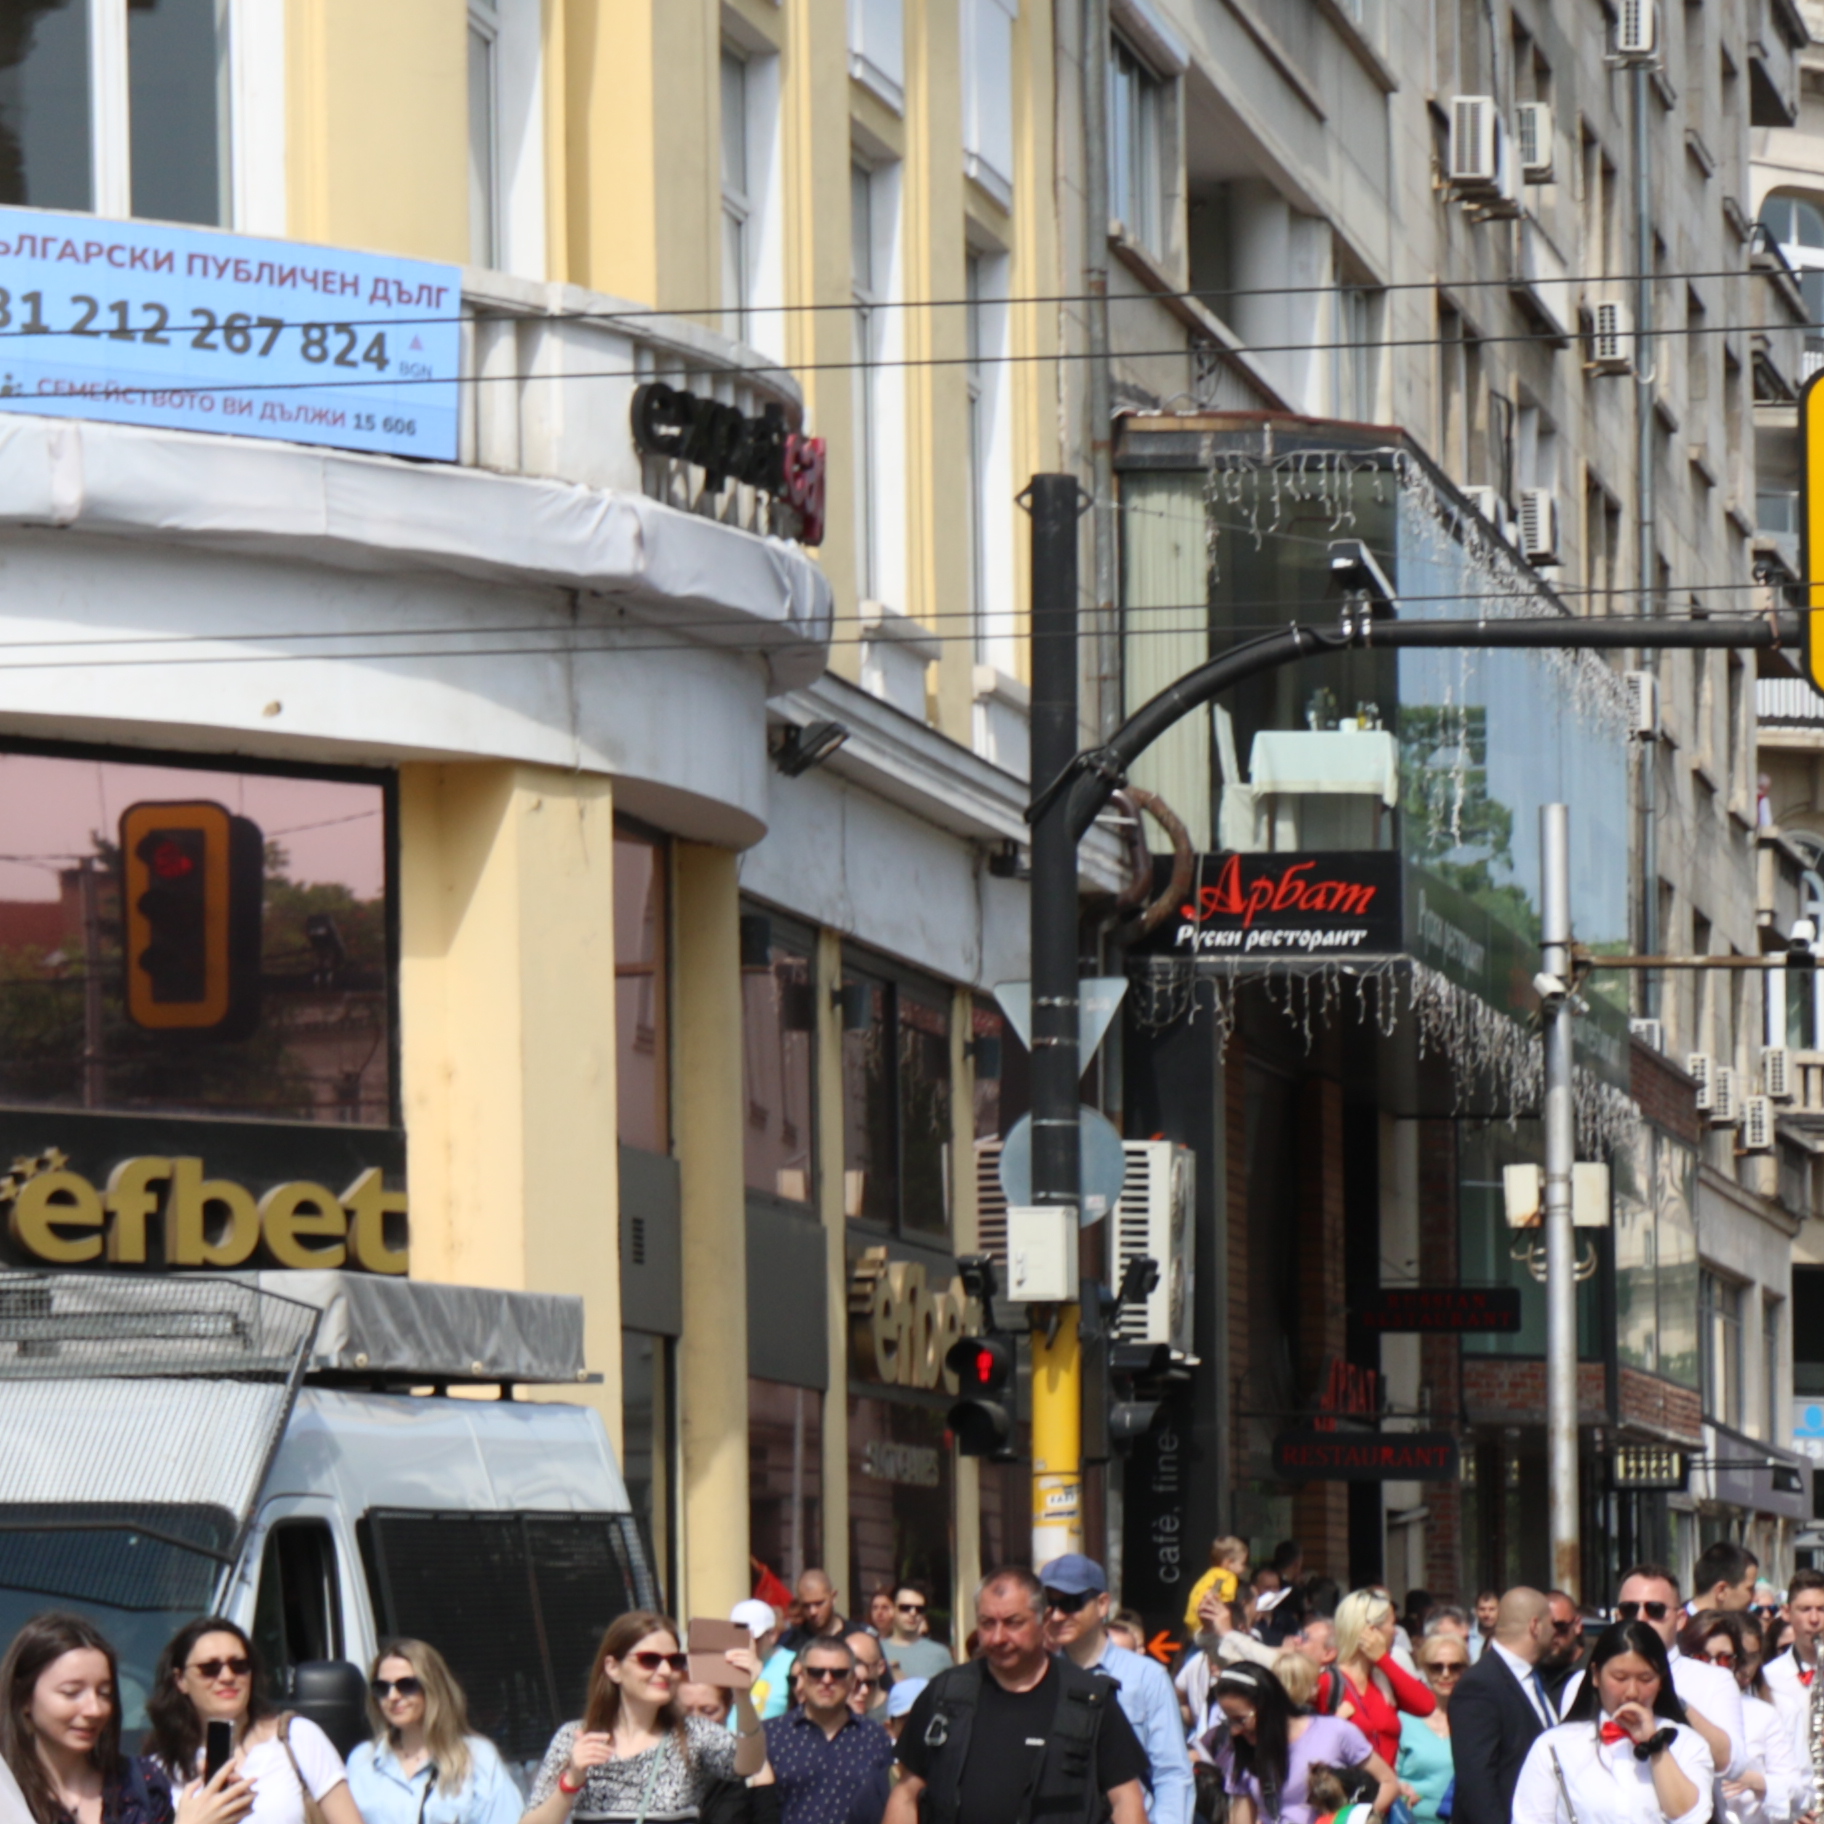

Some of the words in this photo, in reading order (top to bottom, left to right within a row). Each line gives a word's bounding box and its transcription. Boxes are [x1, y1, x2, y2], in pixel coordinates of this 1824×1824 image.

[186, 253, 360, 297] ПУБЛИЧЕН
[368, 276, 449, 310] ДЪЛГ
[69, 294, 172, 346] 212
[190, 308, 284, 358] 267
[300, 322, 390, 373] 824
[37, 377, 215, 412] СЕМЕЙСТВОТО
[222, 396, 254, 418] ВИ
[259, 400, 347, 429] ДЪЛЖИ
[353, 411, 377, 432] 15
[382, 415, 417, 436] 606
[1180, 853, 1377, 928] Арбат
[1174, 923, 1242, 953] Руски
[1245, 928, 1368, 953] ресторант
[10, 1154, 409, 1274] efbet
[1282, 1445, 1451, 1468] RESTAURANT
